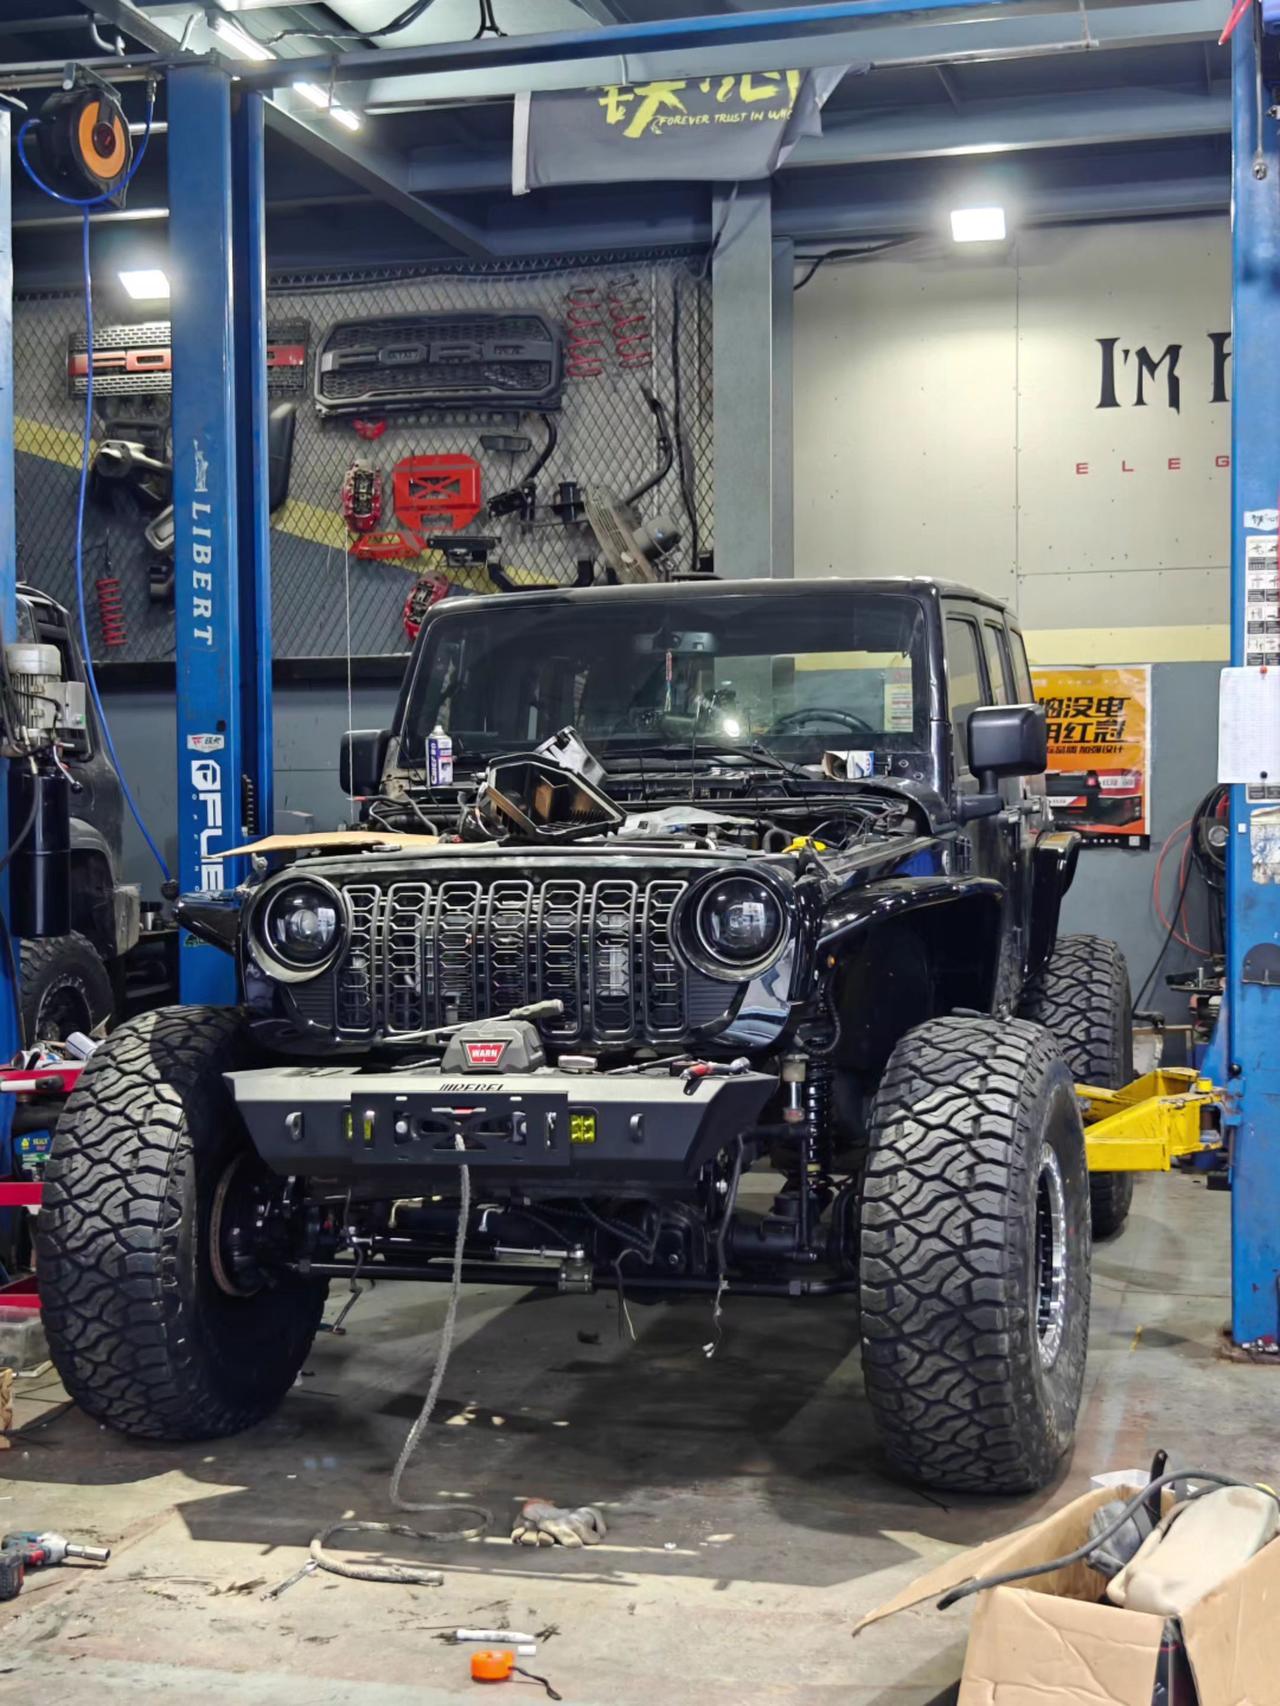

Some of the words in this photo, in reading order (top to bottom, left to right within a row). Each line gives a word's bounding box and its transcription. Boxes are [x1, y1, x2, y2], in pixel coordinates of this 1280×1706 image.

[658, 114, 711, 127] FOREVER
[714, 112, 747, 124] TRUST
[751, 110, 764, 121] IN
[1095, 337, 1183, 415] I'M
[192, 501, 213, 646] LIBERT
[472, 1049, 498, 1058] WARN
